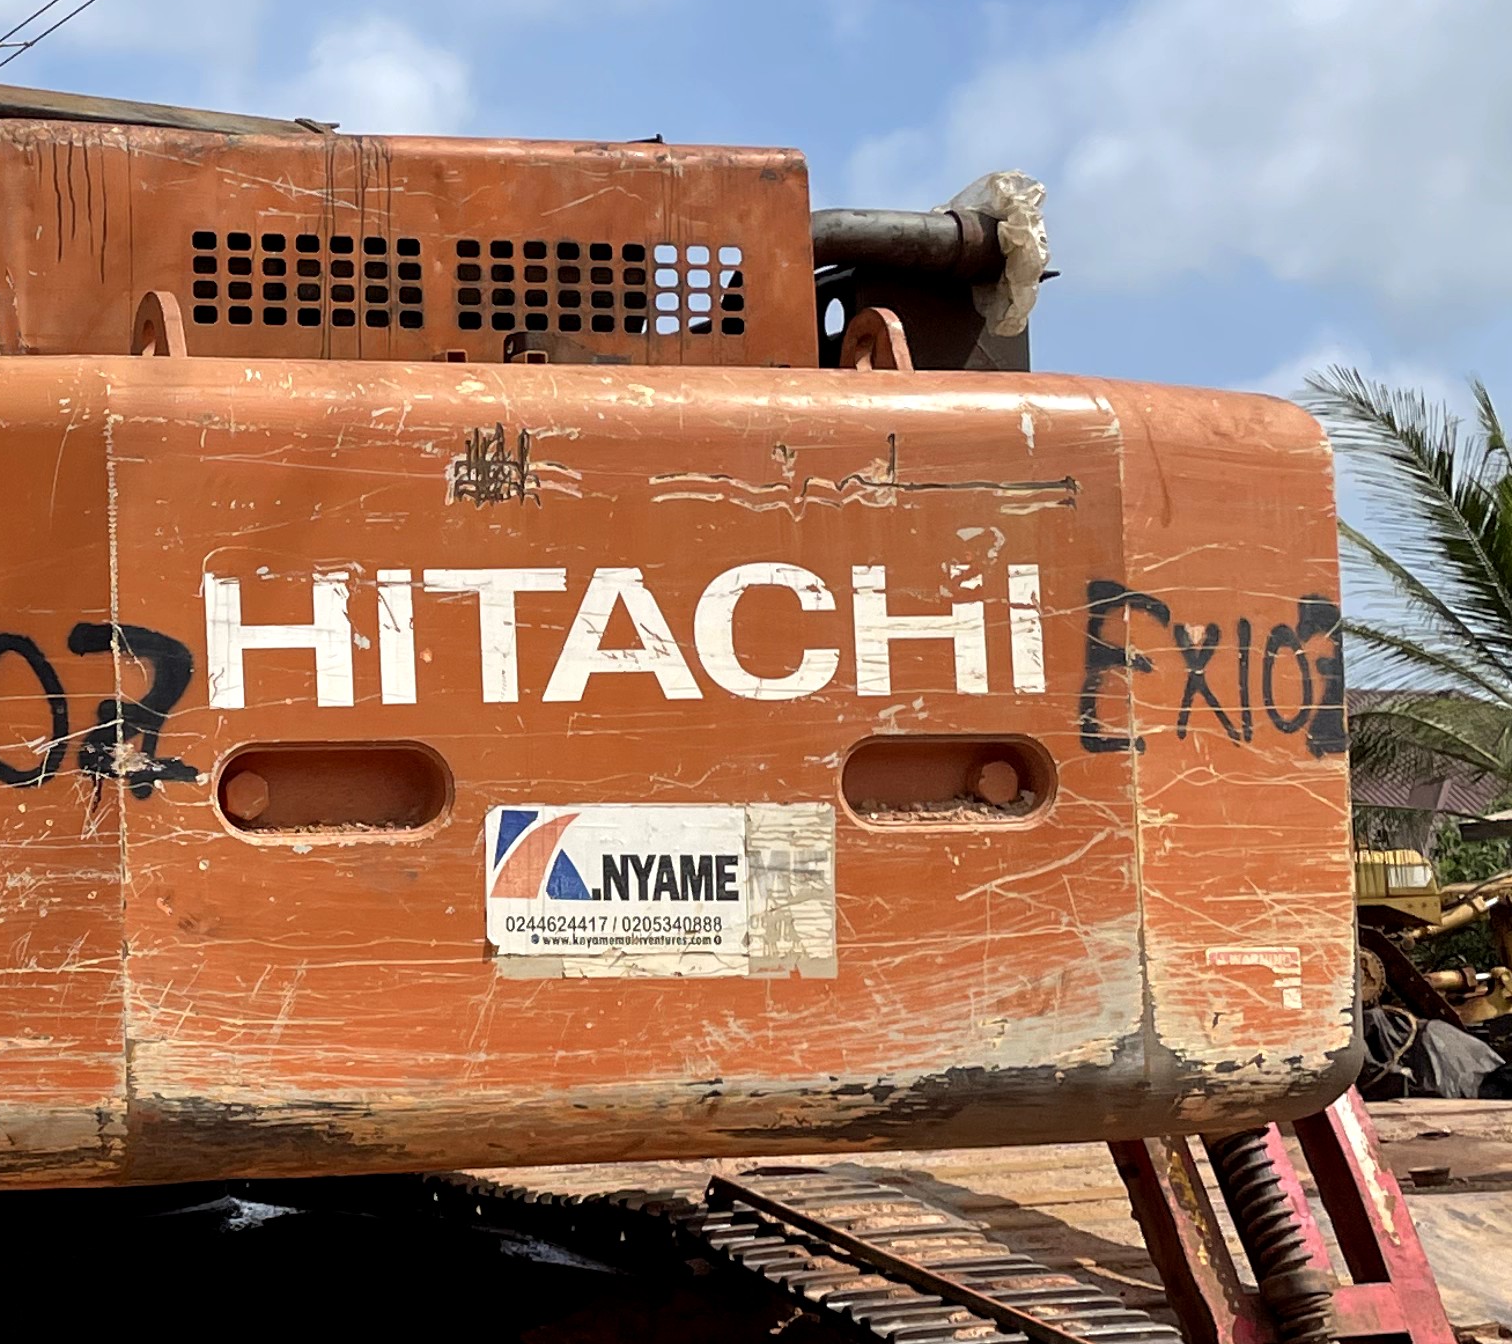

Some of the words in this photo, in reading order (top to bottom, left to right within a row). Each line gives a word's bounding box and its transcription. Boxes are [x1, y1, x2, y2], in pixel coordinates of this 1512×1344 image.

[203, 561, 1048, 709] HITACHI
[505, 915, 607, 932] 0244624417
[621, 915, 722, 932] 0205340888
